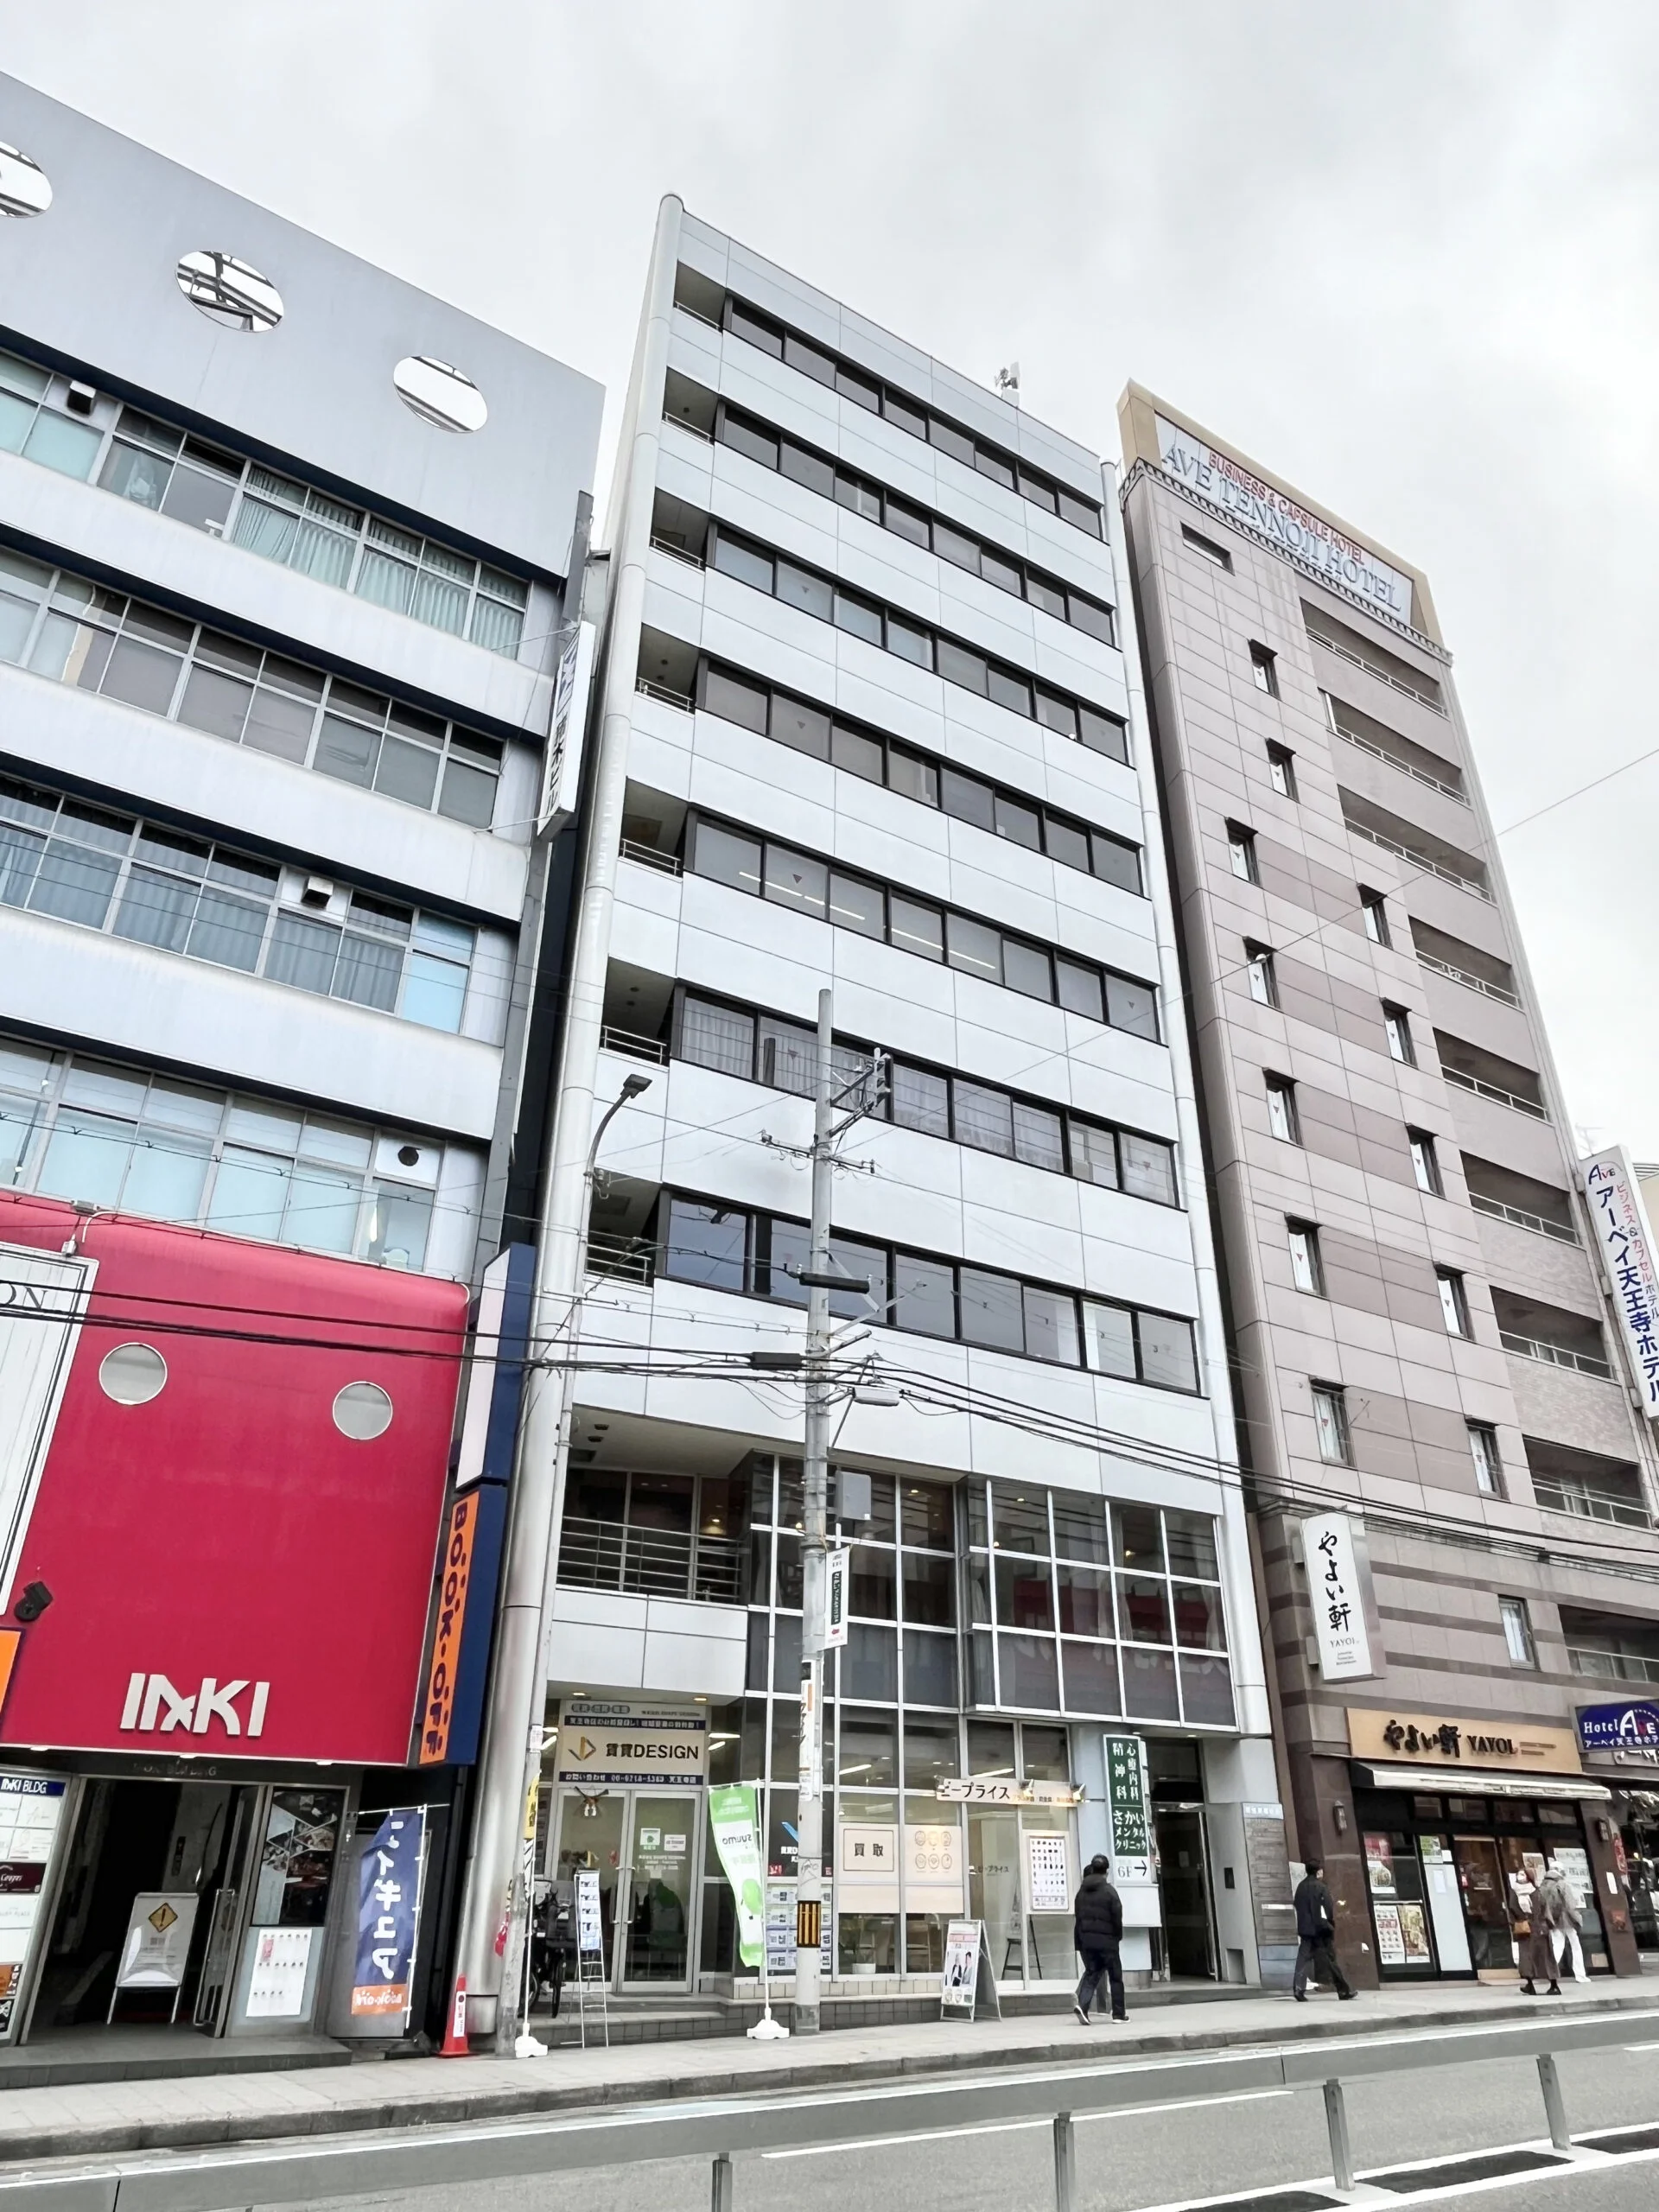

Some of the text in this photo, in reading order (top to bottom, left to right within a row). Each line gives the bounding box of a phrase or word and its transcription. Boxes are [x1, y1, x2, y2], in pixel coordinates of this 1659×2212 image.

[1208, 451, 1366, 565] BUSINESS & CAPSULE HOTEL
[1161, 443, 1213, 493] AVE
[1324, 544, 1402, 612] HOTEL
[1318, 1531, 1351, 1632] やよい軒
[1382, 1719, 1461, 1758] やよい軒
[1584, 1719, 1618, 1733] Hotel
[1112, 1742, 1127, 1801] 精神科
[1113, 1809, 1144, 1826] さかい
[1115, 1827, 1145, 1838] メンタル
[1115, 1839, 1147, 1851] クリニック
[1117, 1866, 1133, 1878] 6F
